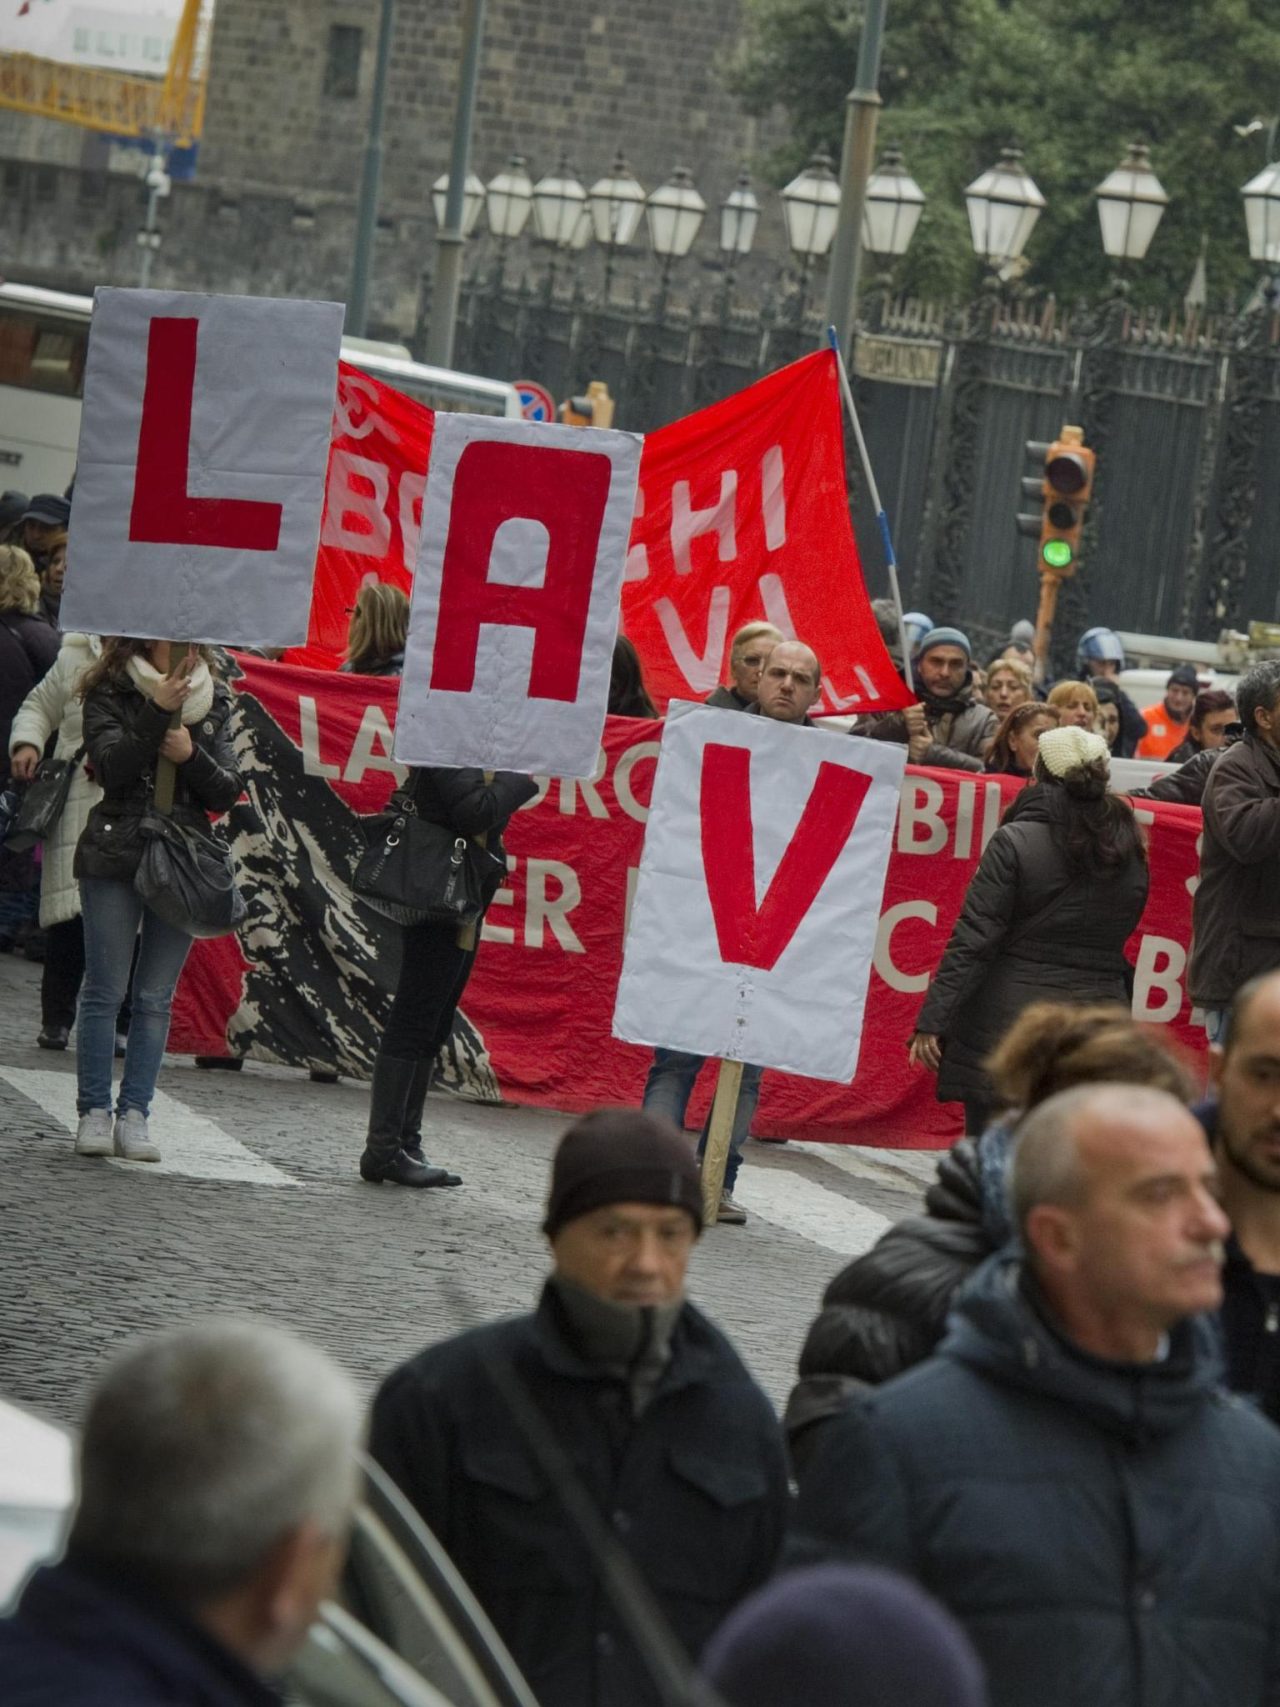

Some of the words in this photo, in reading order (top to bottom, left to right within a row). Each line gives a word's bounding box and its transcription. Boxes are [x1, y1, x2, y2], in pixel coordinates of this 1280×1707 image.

[129, 317, 283, 551] L
[430, 441, 612, 703] A
[700, 743, 873, 971] V
